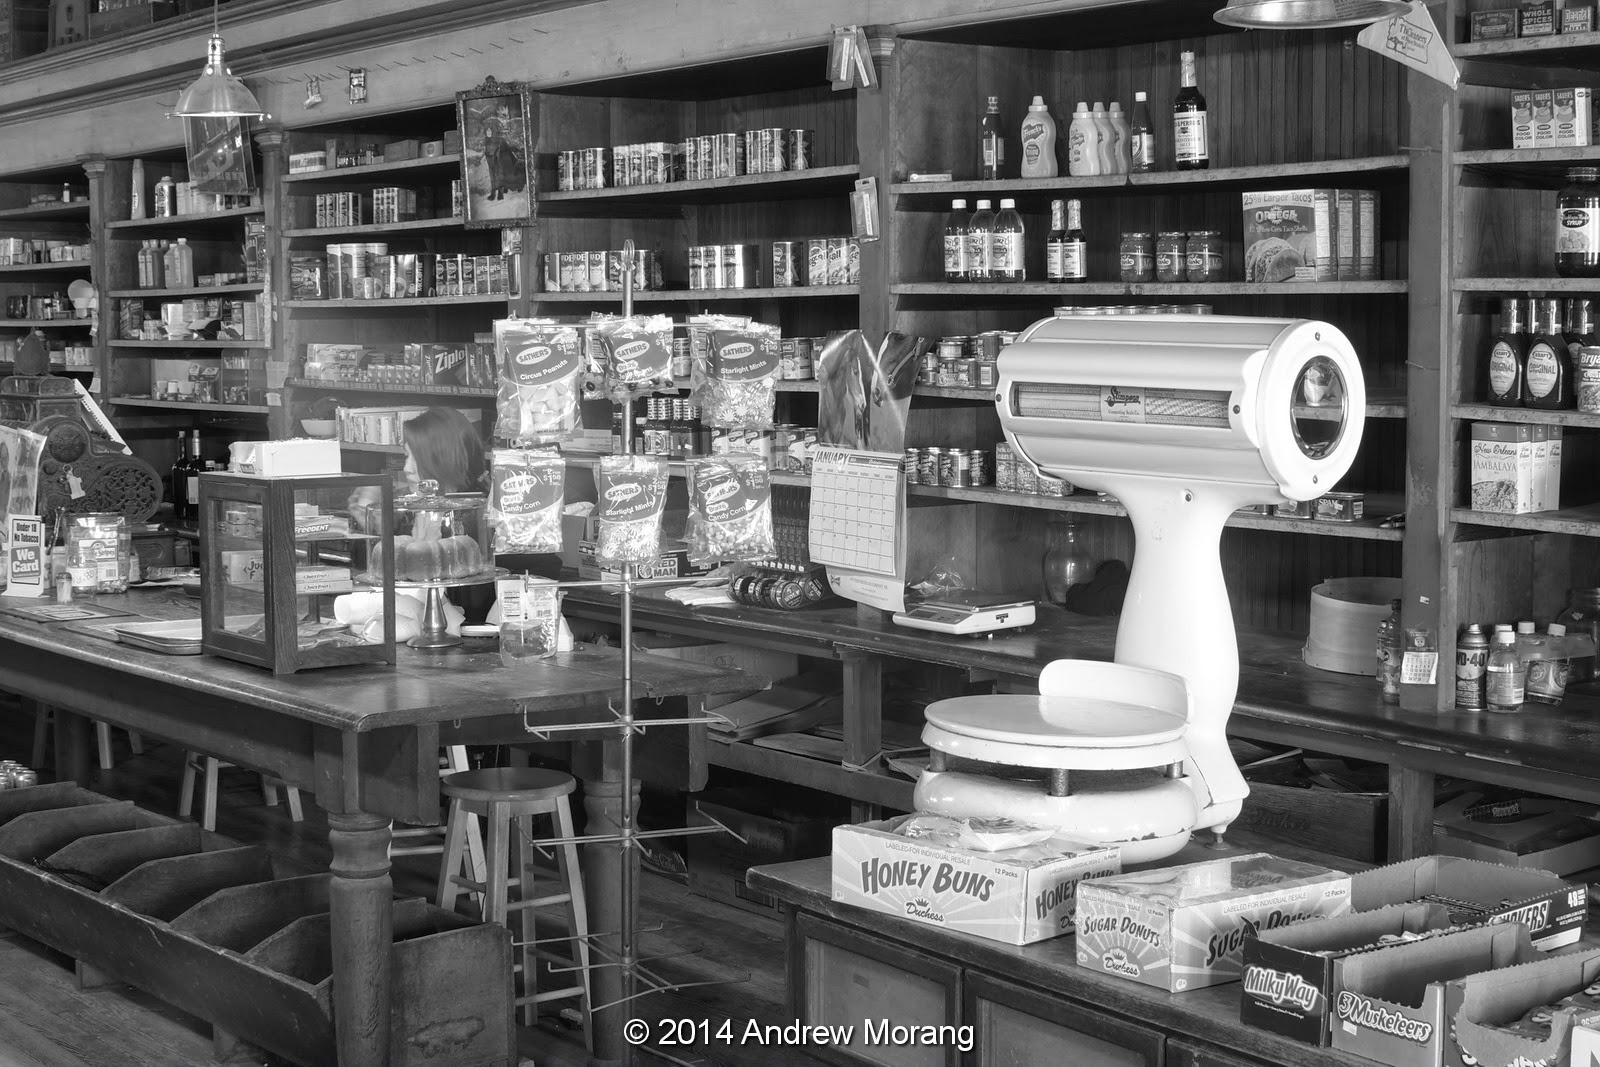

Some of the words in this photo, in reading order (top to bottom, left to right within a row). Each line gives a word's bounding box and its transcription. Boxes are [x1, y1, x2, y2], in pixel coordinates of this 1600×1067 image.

[1522, 8, 1552, 18] WHOLE
[1522, 16, 1552, 24] SPICES
[1244, 193, 1262, 206] 25%
[1264, 192, 1288, 203] Larger
[1292, 192, 1312, 203] Tacos
[518, 348, 550, 363] SATHERS
[616, 342, 648, 358] SATHERS
[722, 346, 752, 356] SATHERS
[520, 372, 542, 381] Circus
[542, 359, 568, 376] Peanuts
[720, 366, 749, 374] Starlight
[750, 360, 767, 370] Mints
[1491, 361, 1514, 372] ORIGINAL
[1528, 362, 1556, 374] ORIGINAL
[1474, 442, 1492, 454] New
[1493, 444, 1517, 456] Orleans
[814, 451, 849, 465] JANUARY
[1473, 460, 1517, 472] JAMBALAYA
[503, 505, 523, 513] Candy
[523, 500, 540, 510] Corn
[605, 506, 634, 516] Starlight
[708, 512, 729, 521] Candy
[729, 506, 745, 516] Corn
[16, 521, 30, 533] Under
[30, 523, 37, 533] 18
[14, 533, 20, 542] No
[20, 534, 39, 544] Tobacco
[16, 548, 35, 562] We
[12, 558, 40, 574] Card
[654, 567, 676, 578] MAN
[885, 842, 908, 853] LABELED
[920, 849, 950, 861] INDIVIDUAL
[951, 855, 971, 865] RESALE
[861, 858, 932, 894] HONEY
[932, 863, 995, 902] BUNS
[1001, 869, 1018, 878] Packs
[1036, 878, 1078, 920] HONEY
[1223, 905, 1247, 914] LABELED
[1258, 898, 1288, 908] INDIVIDUAL
[1288, 892, 1306, 902] RESALE
[1568, 892, 1578, 908] 48
[906, 902, 944, 923] Duchess
[1084, 916, 1117, 935] SUGAR
[1120, 916, 1160, 947] DONUTS
[1104, 957, 1138, 976] Duchess
[1246, 967, 1284, 1002] Milky
[1284, 975, 1315, 1010] Way
[1339, 993, 1351, 1012] 3
[1350, 999, 1431, 1041] Musketeers
